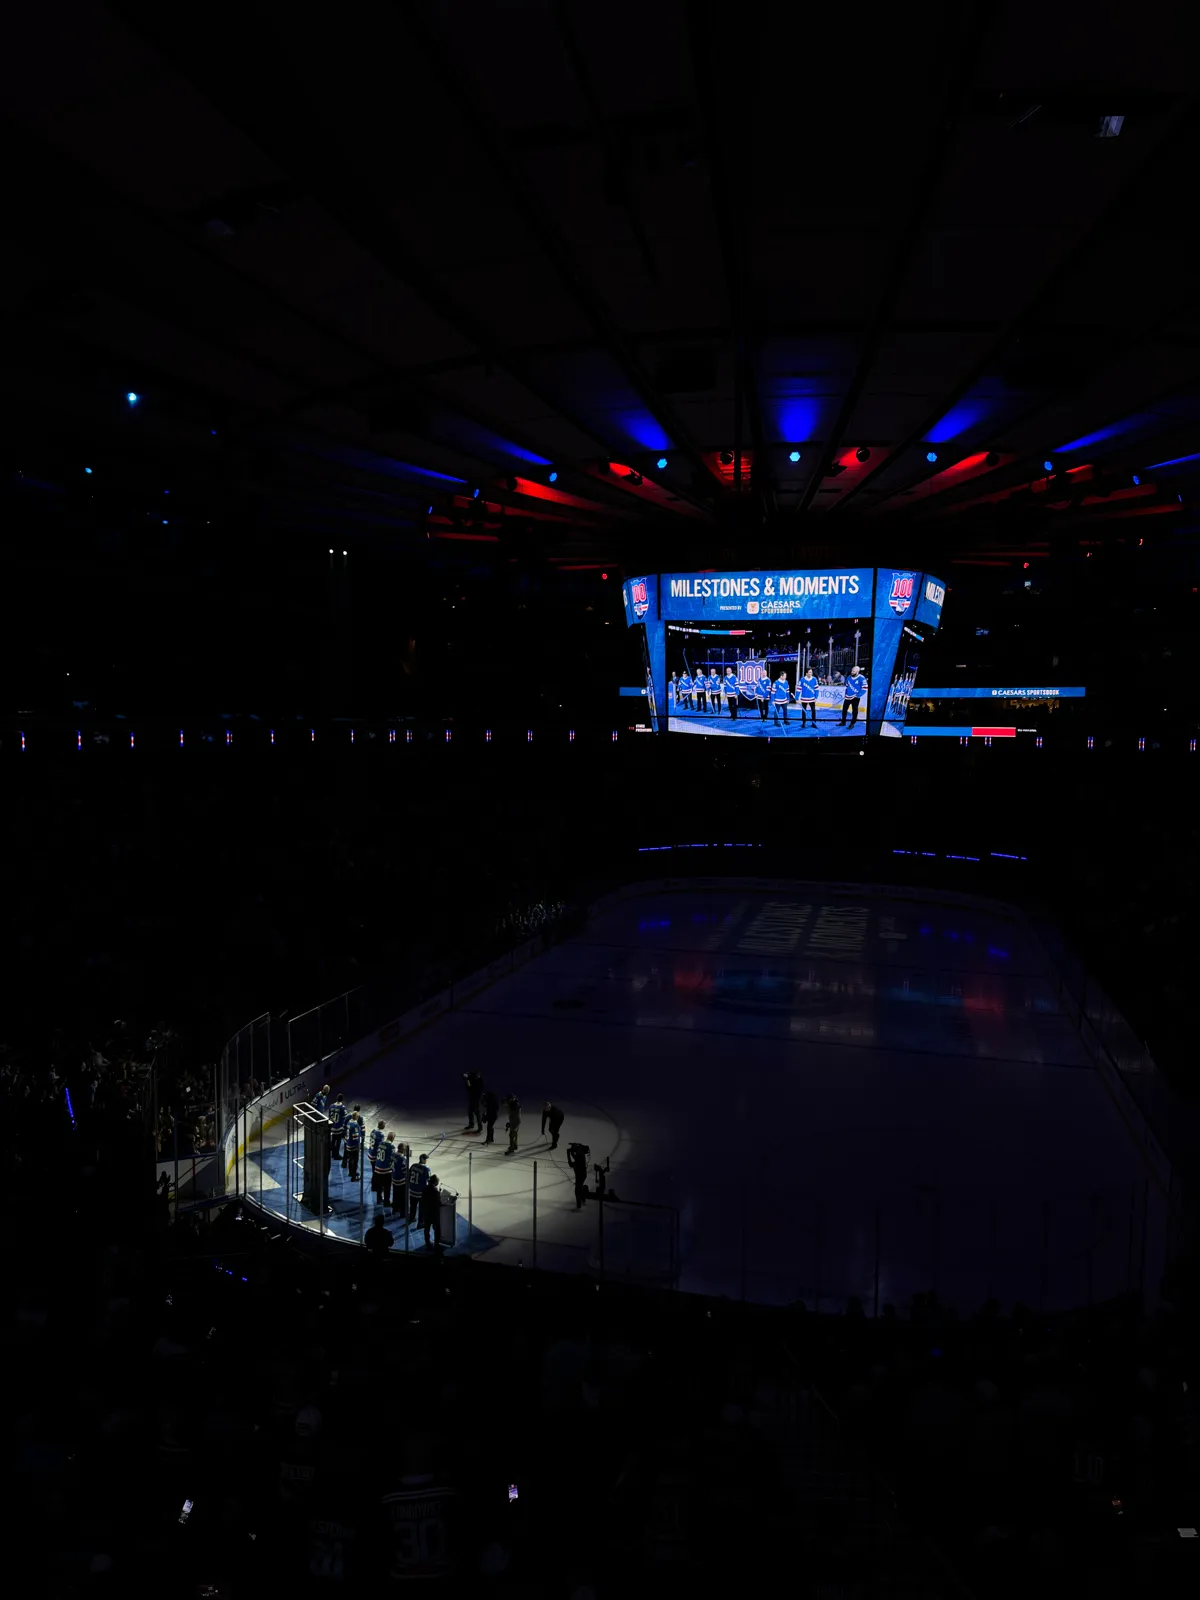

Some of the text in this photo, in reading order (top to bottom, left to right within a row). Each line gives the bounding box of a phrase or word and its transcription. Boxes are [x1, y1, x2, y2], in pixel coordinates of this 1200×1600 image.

[671, 575, 860, 598] MILESTONES & MOMENTS
[760, 600, 801, 609] CAESARS
[739, 665, 762, 684] 100
[285, 1081, 307, 1100] ULTRA
[409, 1170, 420, 1185] 21
